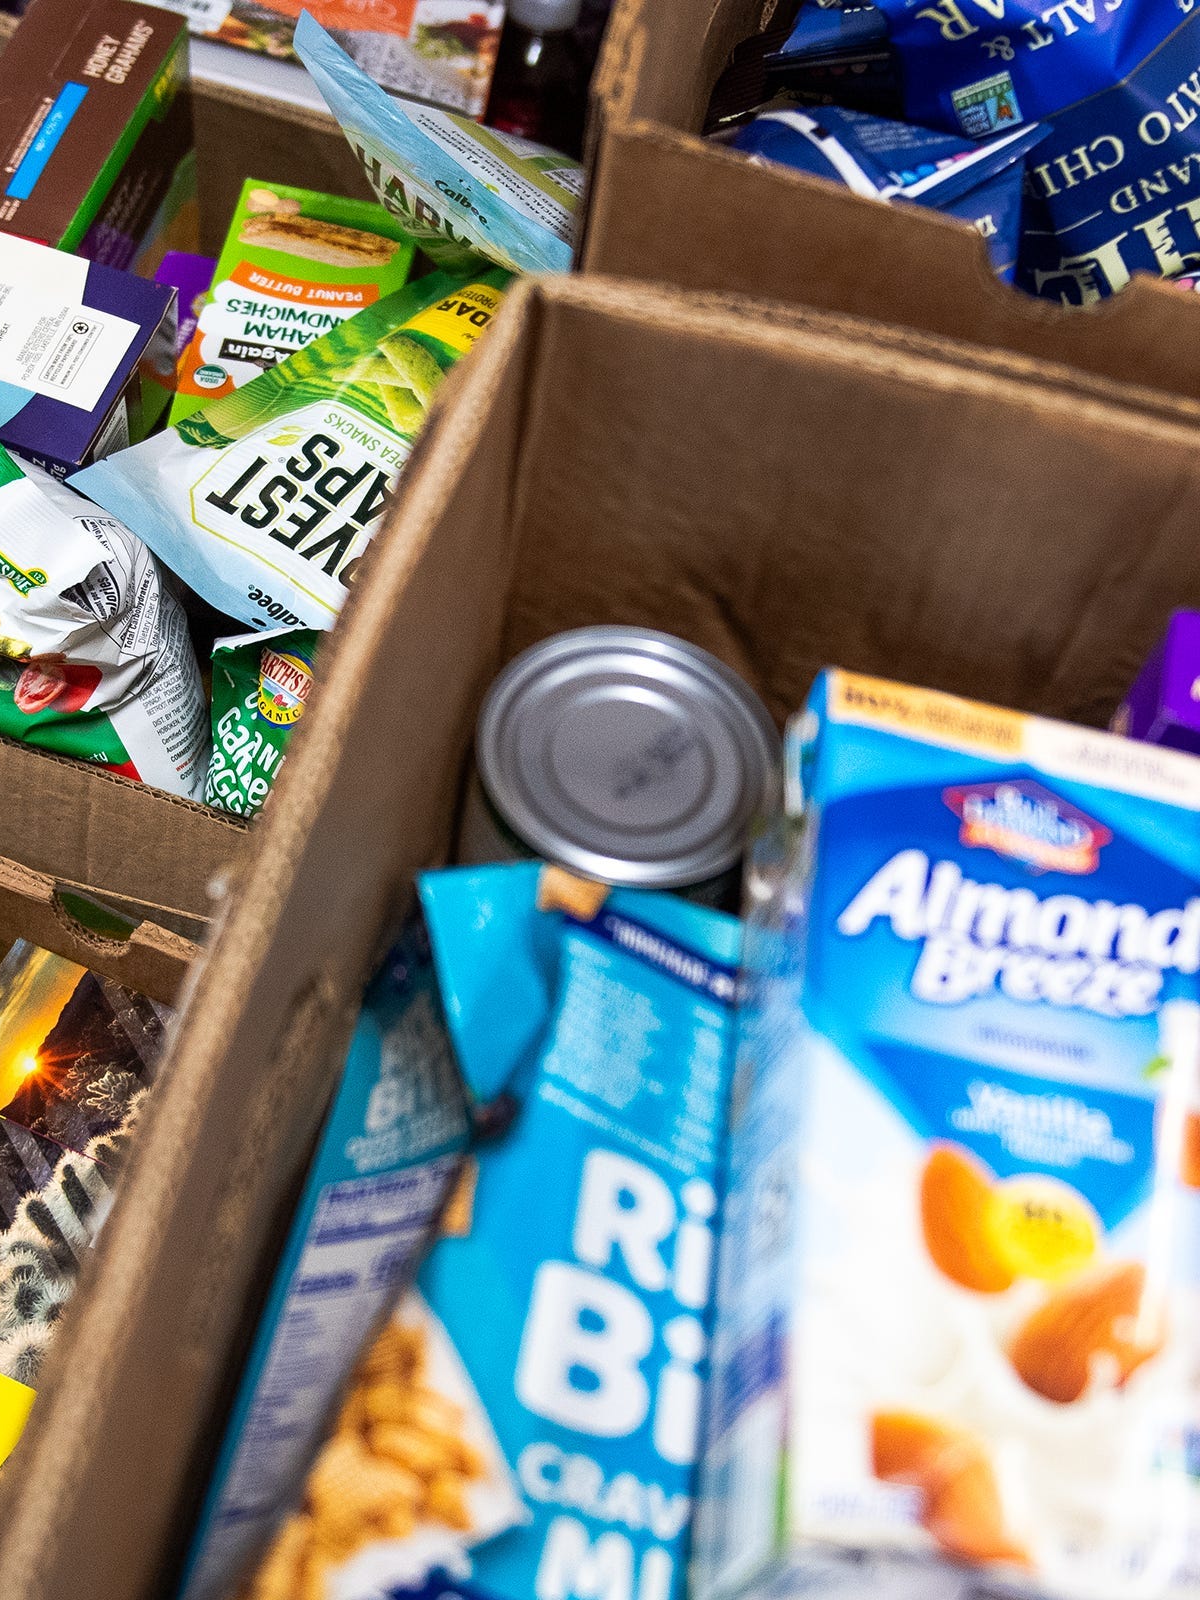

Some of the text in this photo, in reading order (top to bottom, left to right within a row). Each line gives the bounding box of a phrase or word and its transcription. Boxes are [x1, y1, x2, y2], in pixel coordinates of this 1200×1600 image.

[1020, 0, 1122, 51] ALT
[83, 33, 121, 78] HONEY
[104, 19, 155, 85] GRAHAMS
[981, 35, 1015, 60] &
[416, 118, 466, 157] INGREDIENT
[480, 163, 495, 176] THE
[1030, 136, 1125, 198] CHI
[434, 178, 490, 230] Calbee
[497, 176, 524, 203] ALWAYS
[248, 271, 363, 301] PEANUT BUTTER
[225, 298, 345, 329] NDWICHES
[243, 321, 320, 345] AHAM
[15, 328, 42, 362] MANUFACTURED
[223, 343, 290, 362] Again
[323, 411, 405, 470] PEA SNACKS
[286, 433, 393, 528] APS
[206, 455, 364, 590] VEST
[124, 569, 154, 649] Total Carbohydrates 4g
[138, 621, 152, 644] Dietary
[147, 603, 155, 622] Fiber
[261, 651, 303, 694] ARTH'S
[162, 727, 181, 745] Certified
[166, 735, 189, 753] Assurance
[838, 848, 1200, 974] Almond
[910, 932, 1165, 1018] Breeze
